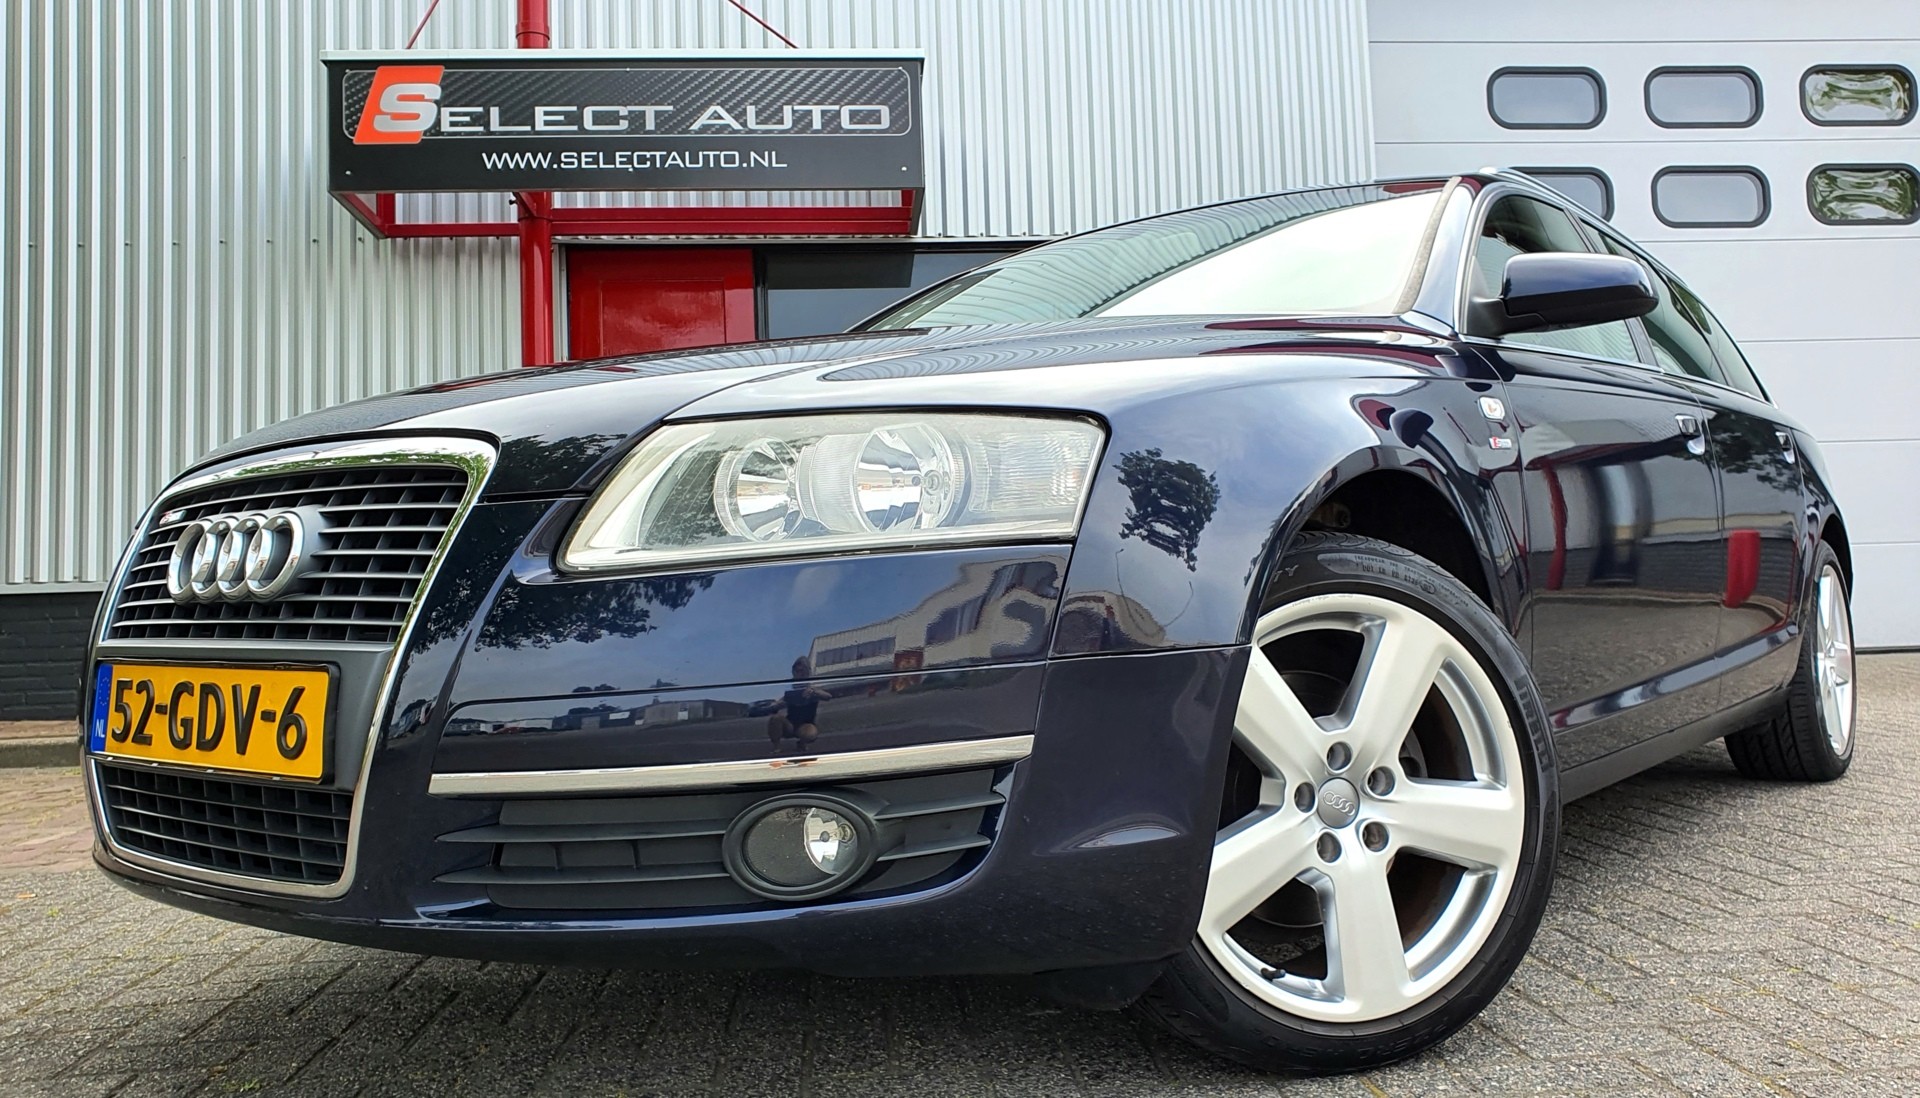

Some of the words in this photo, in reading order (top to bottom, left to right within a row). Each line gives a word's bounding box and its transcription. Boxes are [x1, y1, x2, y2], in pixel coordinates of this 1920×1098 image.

[373, 83, 673, 132] SELECT
[688, 105, 890, 130] AUTO
[481, 151, 788, 170] WWW.SELECTAUTO.NL
[95, 720, 105, 739] NL
[111, 678, 307, 761] 52-GDV-6
